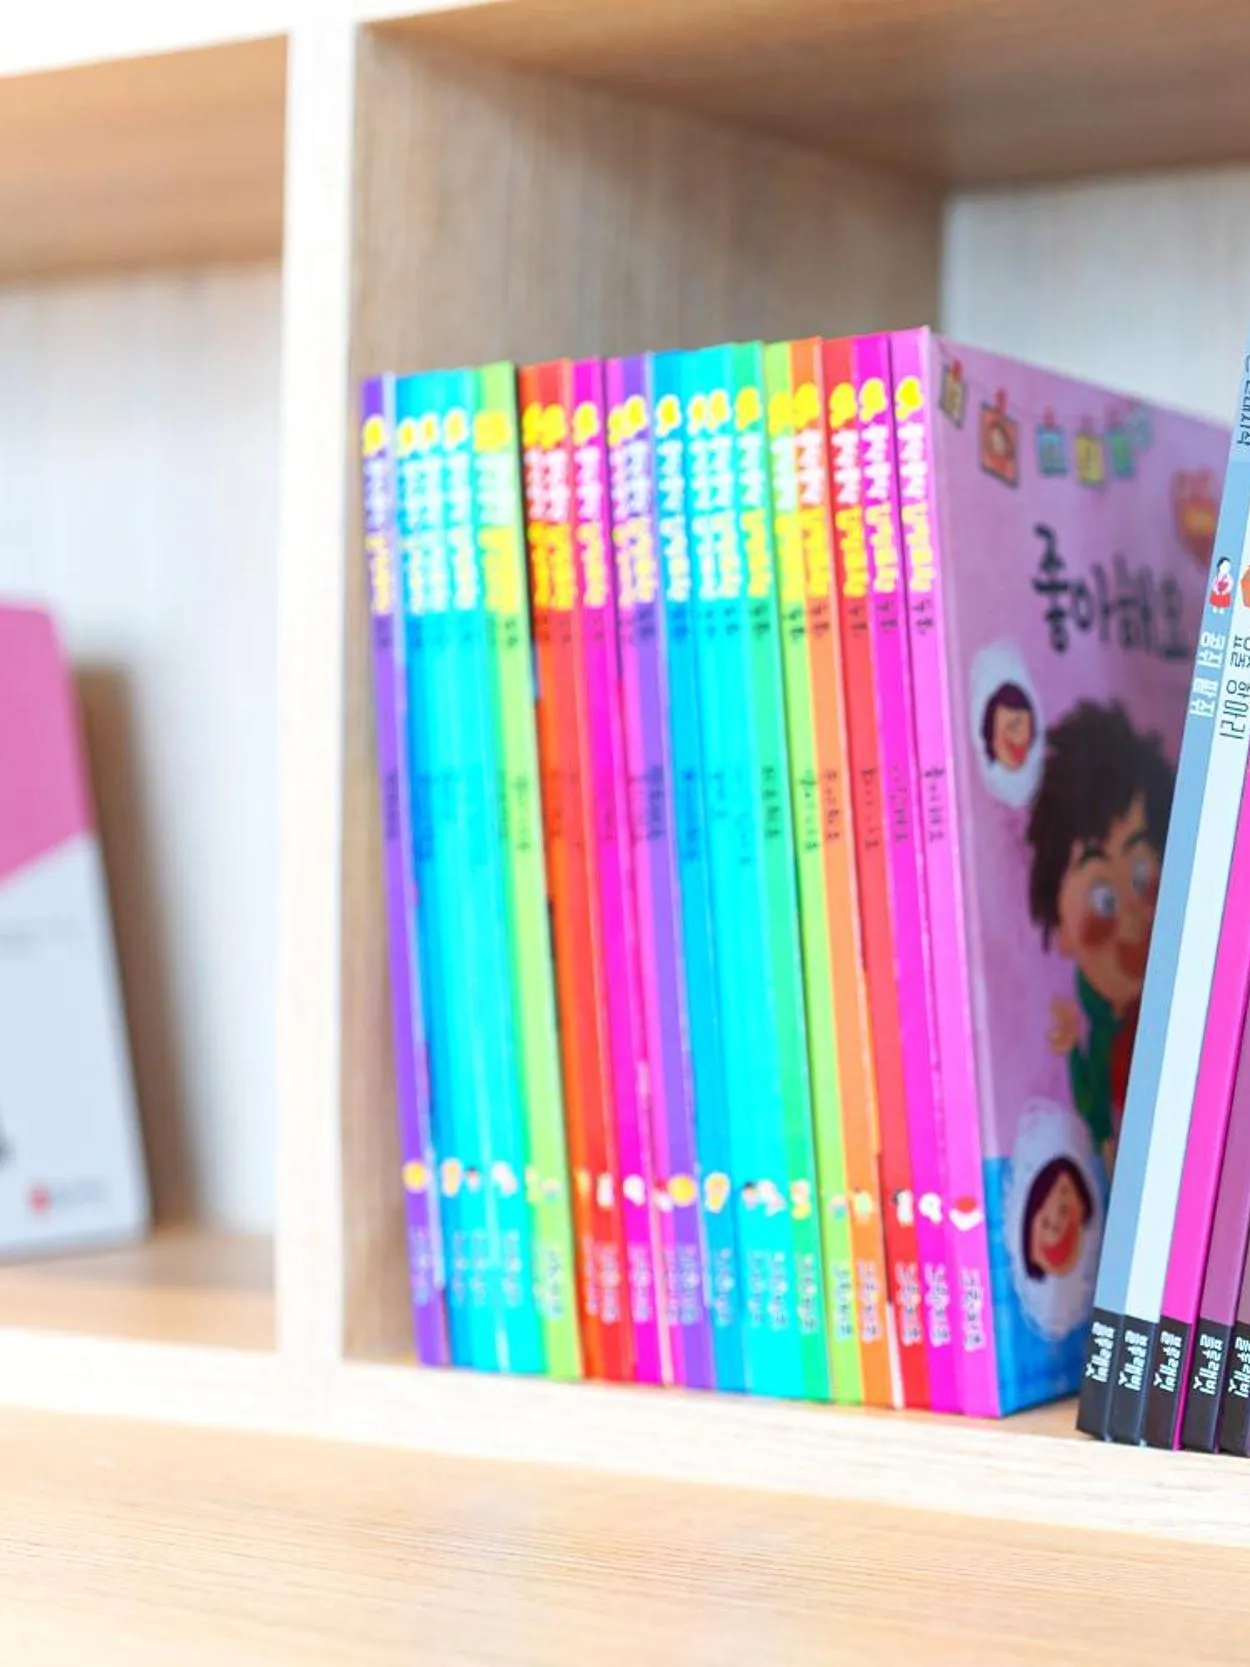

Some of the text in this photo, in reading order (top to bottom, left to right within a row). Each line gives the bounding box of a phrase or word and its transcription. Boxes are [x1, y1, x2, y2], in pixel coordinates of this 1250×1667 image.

[1189, 631, 1224, 718] 콩쥐 팥쥐
[1119, 1330, 1148, 1391] 블루래빗
[1153, 1331, 1182, 1392] 블루래빗
[1192, 1333, 1222, 1395] 블루래빗
